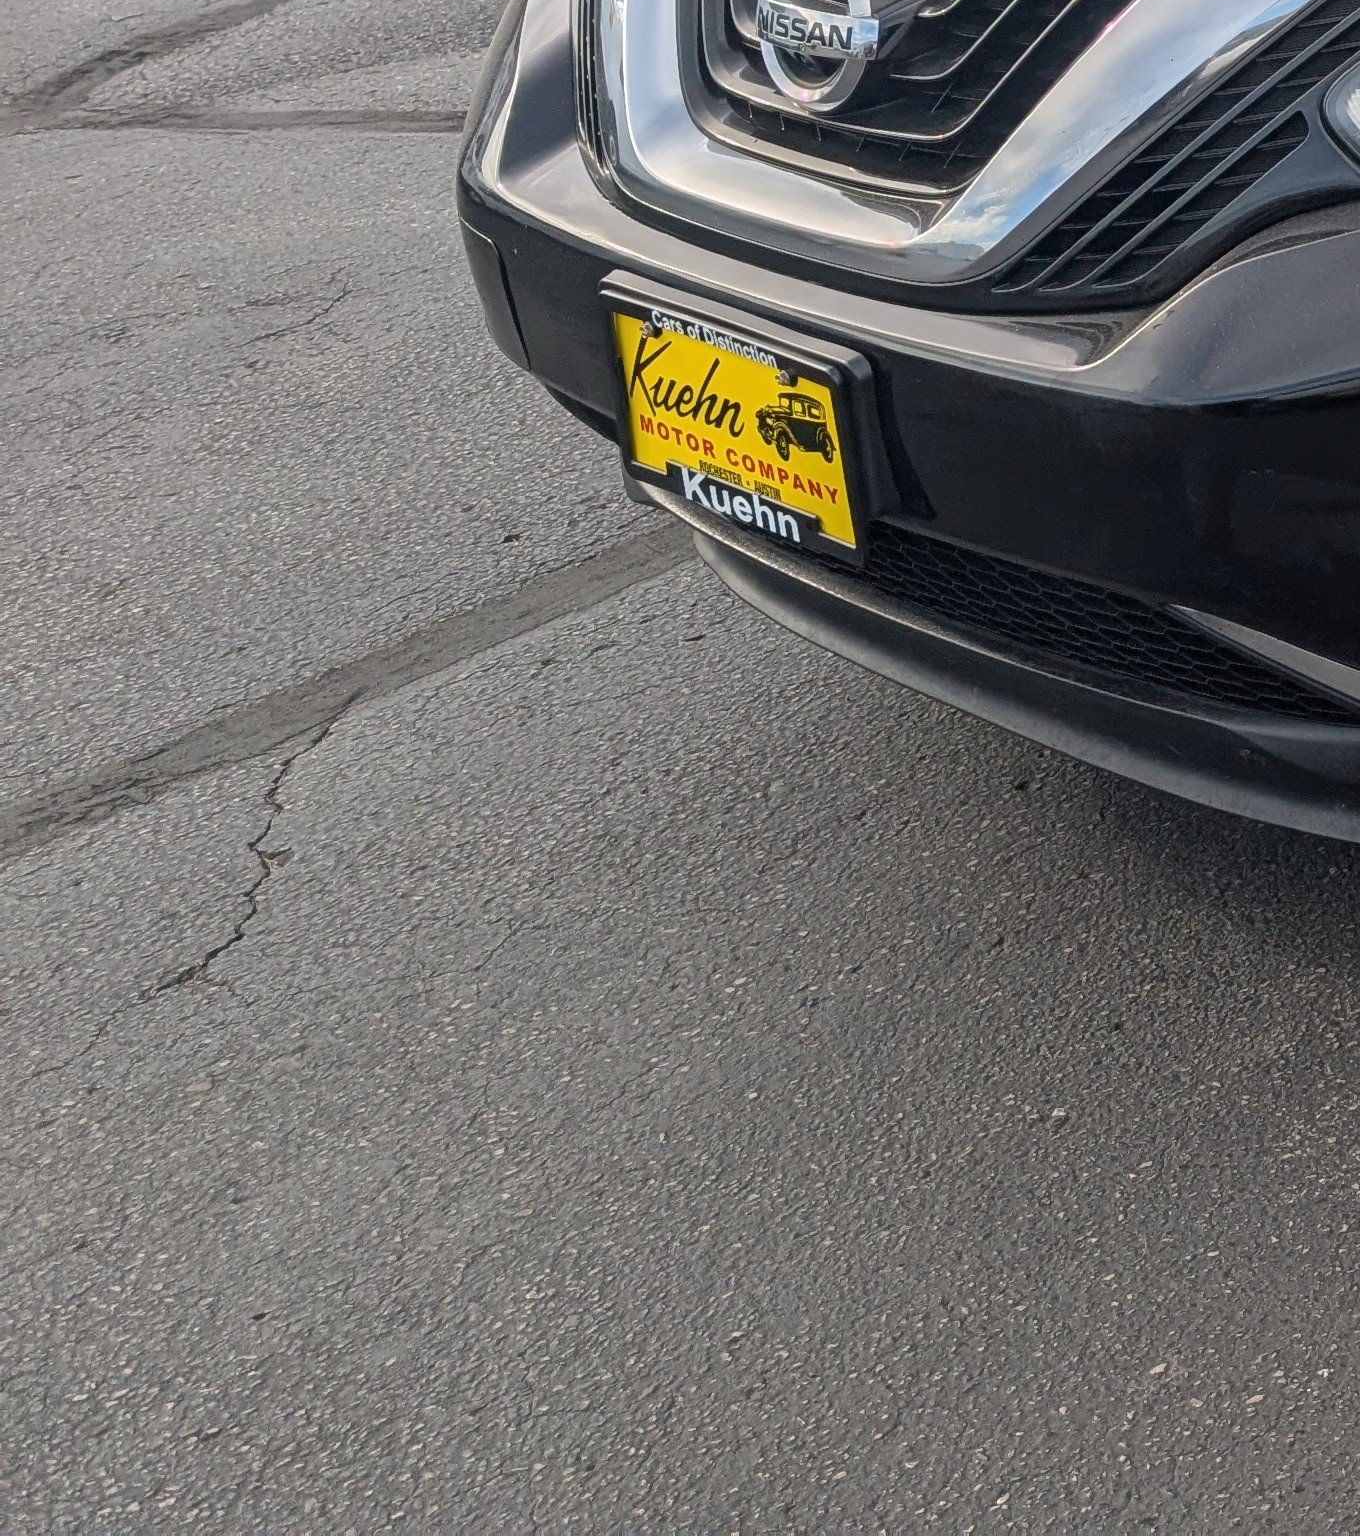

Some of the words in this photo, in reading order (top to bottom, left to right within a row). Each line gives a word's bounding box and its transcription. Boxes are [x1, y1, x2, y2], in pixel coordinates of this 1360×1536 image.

[757, 8, 854, 51] NISSAN
[651, 309, 685, 337] Cars
[686, 323, 701, 342] of
[702, 330, 778, 370] Distinction
[629, 334, 746, 438] Kuehn
[639, 414, 717, 460] MOTOR
[726, 447, 840, 506] COMPANY
[679, 464, 801, 544] Kuehn
